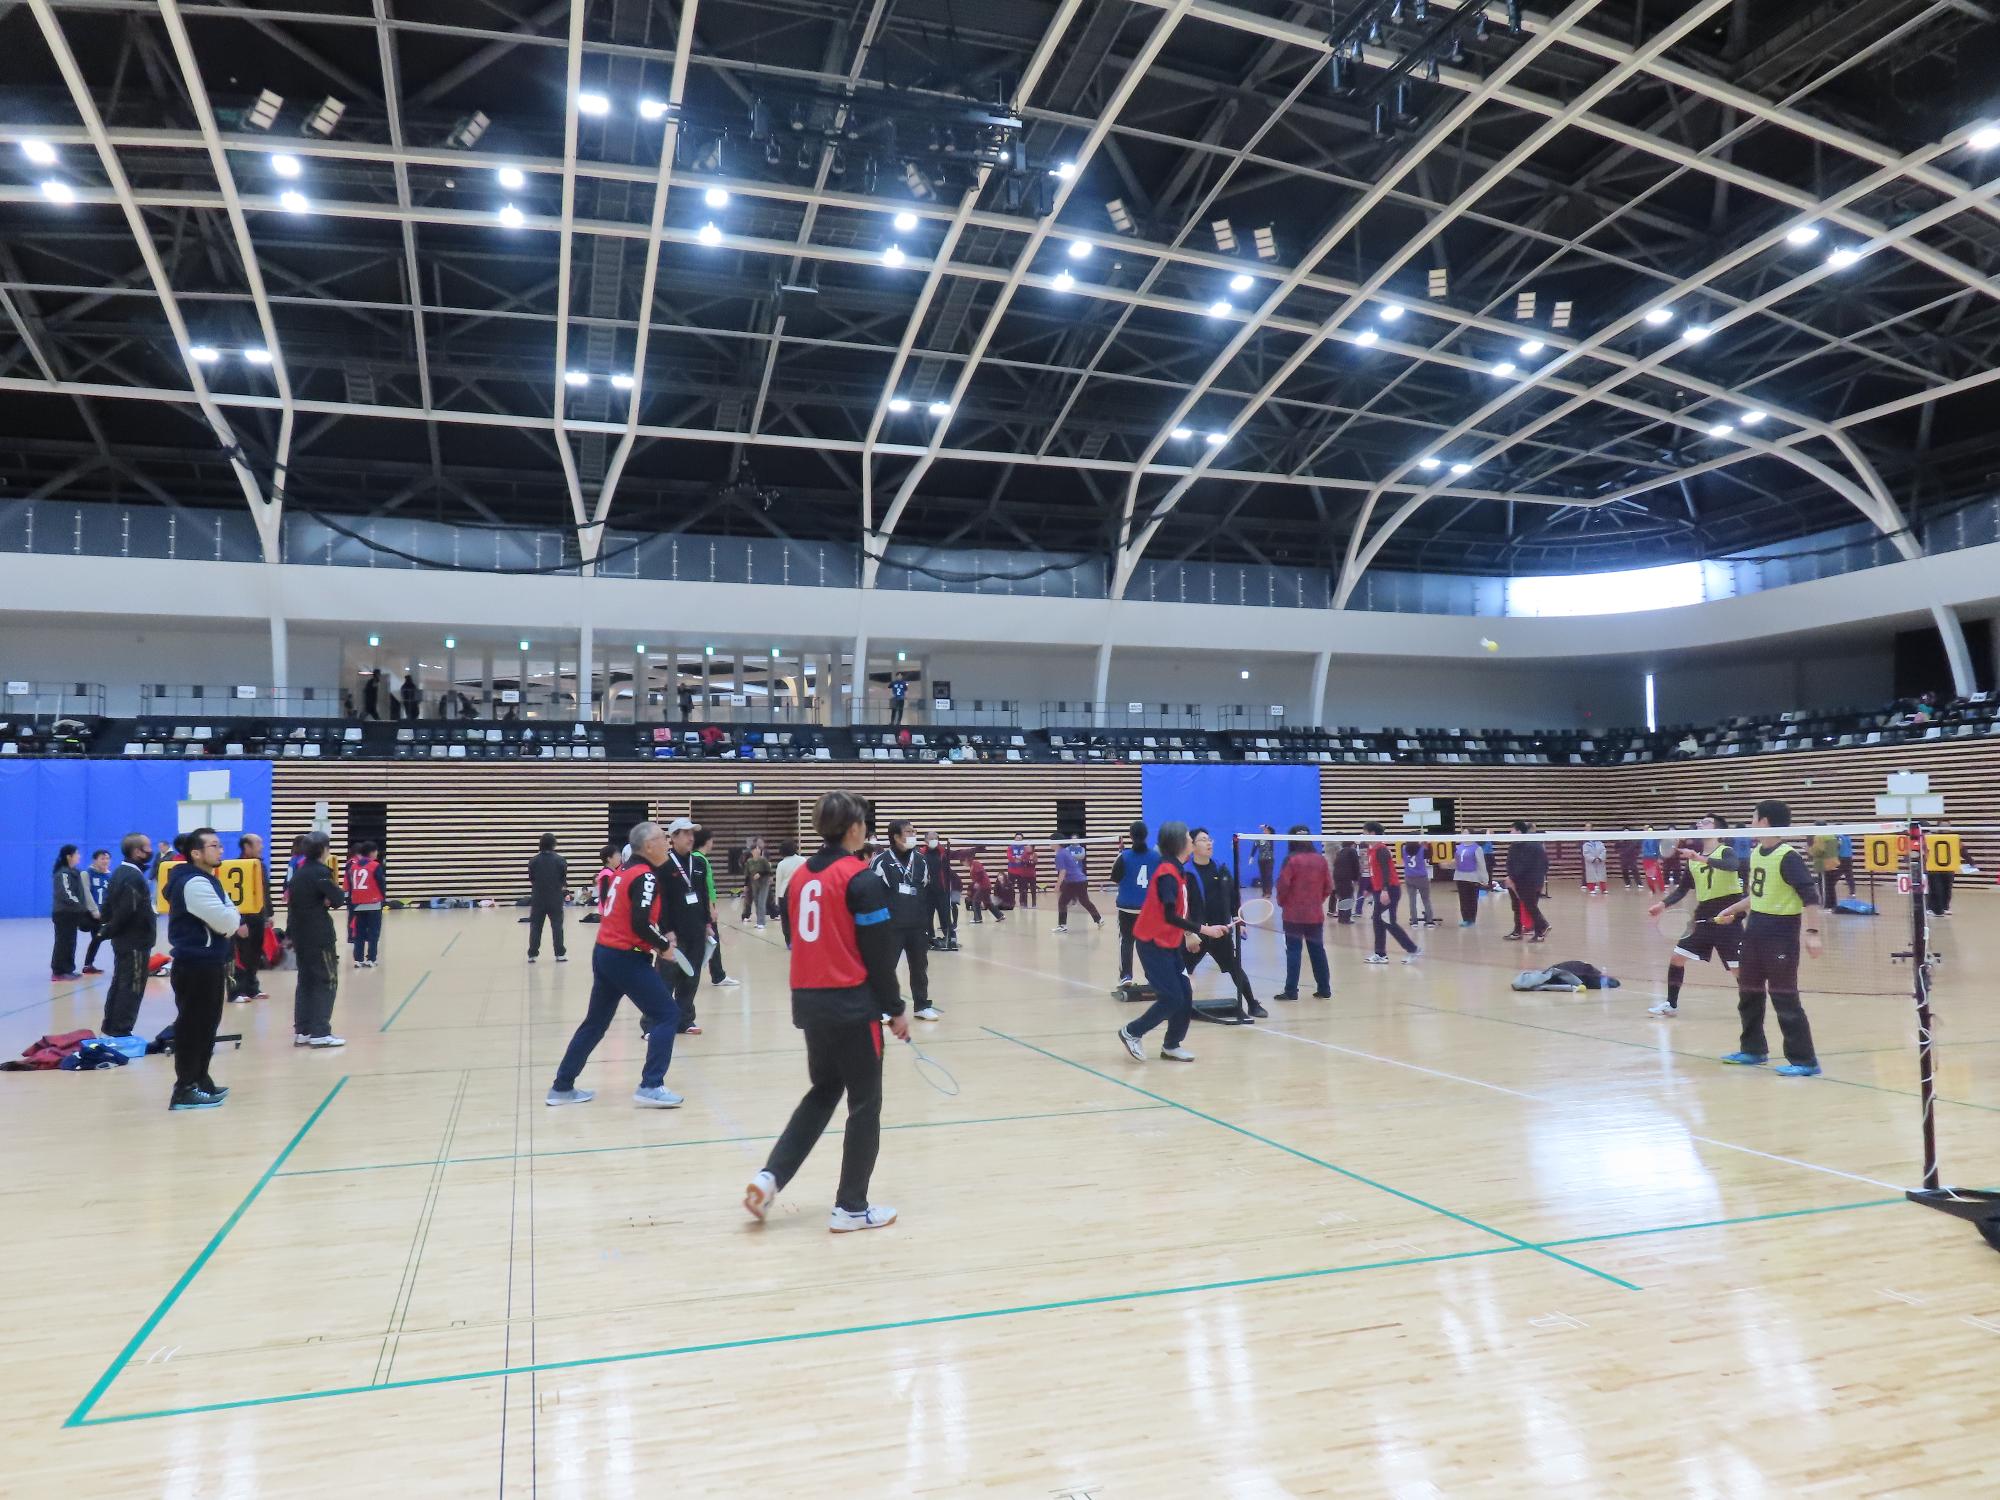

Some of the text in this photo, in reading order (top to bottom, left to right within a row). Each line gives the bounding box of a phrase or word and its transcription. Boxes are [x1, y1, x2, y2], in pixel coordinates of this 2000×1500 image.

[1873, 840, 1889, 867] 0
[1934, 840, 1951, 867] 0
[227, 867, 244, 906] 3
[352, 868, 369, 890] 12
[1136, 864, 1149, 888] 4
[1700, 865, 1713, 889] 7
[1751, 867, 1766, 897] 8
[603, 875, 622, 917] 5
[798, 879, 822, 942] 6
